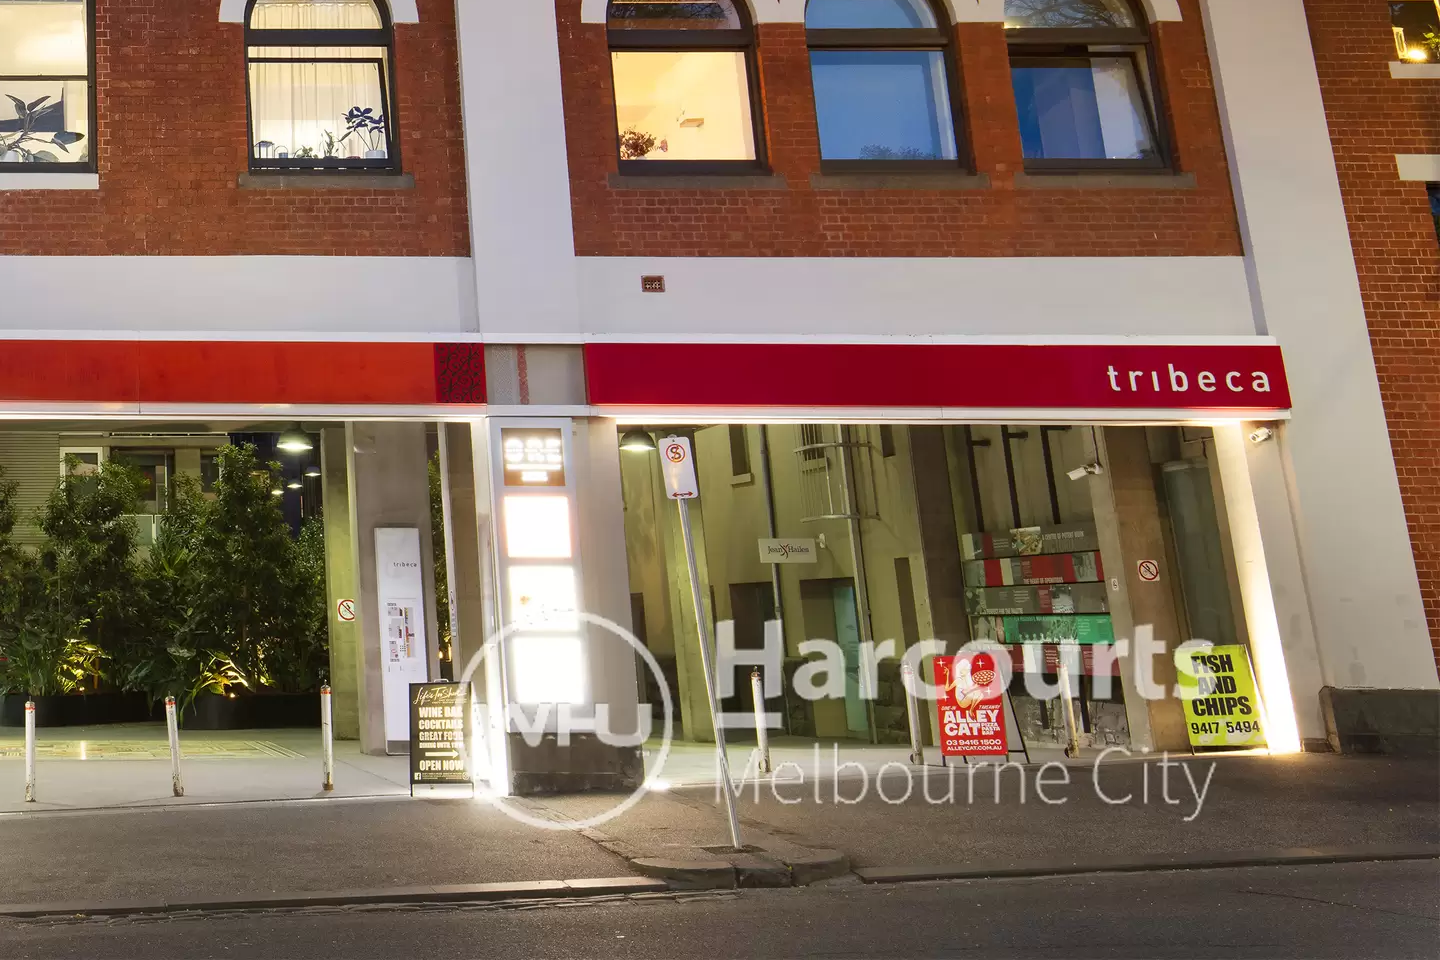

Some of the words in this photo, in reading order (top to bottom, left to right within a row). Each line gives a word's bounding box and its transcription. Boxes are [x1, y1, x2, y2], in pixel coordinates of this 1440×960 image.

[1107, 363, 1271, 392] tribeca
[1191, 654, 1234, 674] FISH
[1197, 676, 1237, 695] AND
[418, 707, 443, 718] WINE
[444, 706, 463, 718] BAR
[1191, 696, 1252, 716] CHIPS
[944, 709, 999, 724] ALLEY
[418, 719, 463, 730] COCKTAILS
[944, 723, 980, 736] CAT
[1191, 722, 1219, 734] 9417
[1226, 721, 1260, 733] 5494
[419, 731, 443, 741] GREAT
[419, 760, 441, 771] OPEN
[442, 760, 464, 771] NOW
